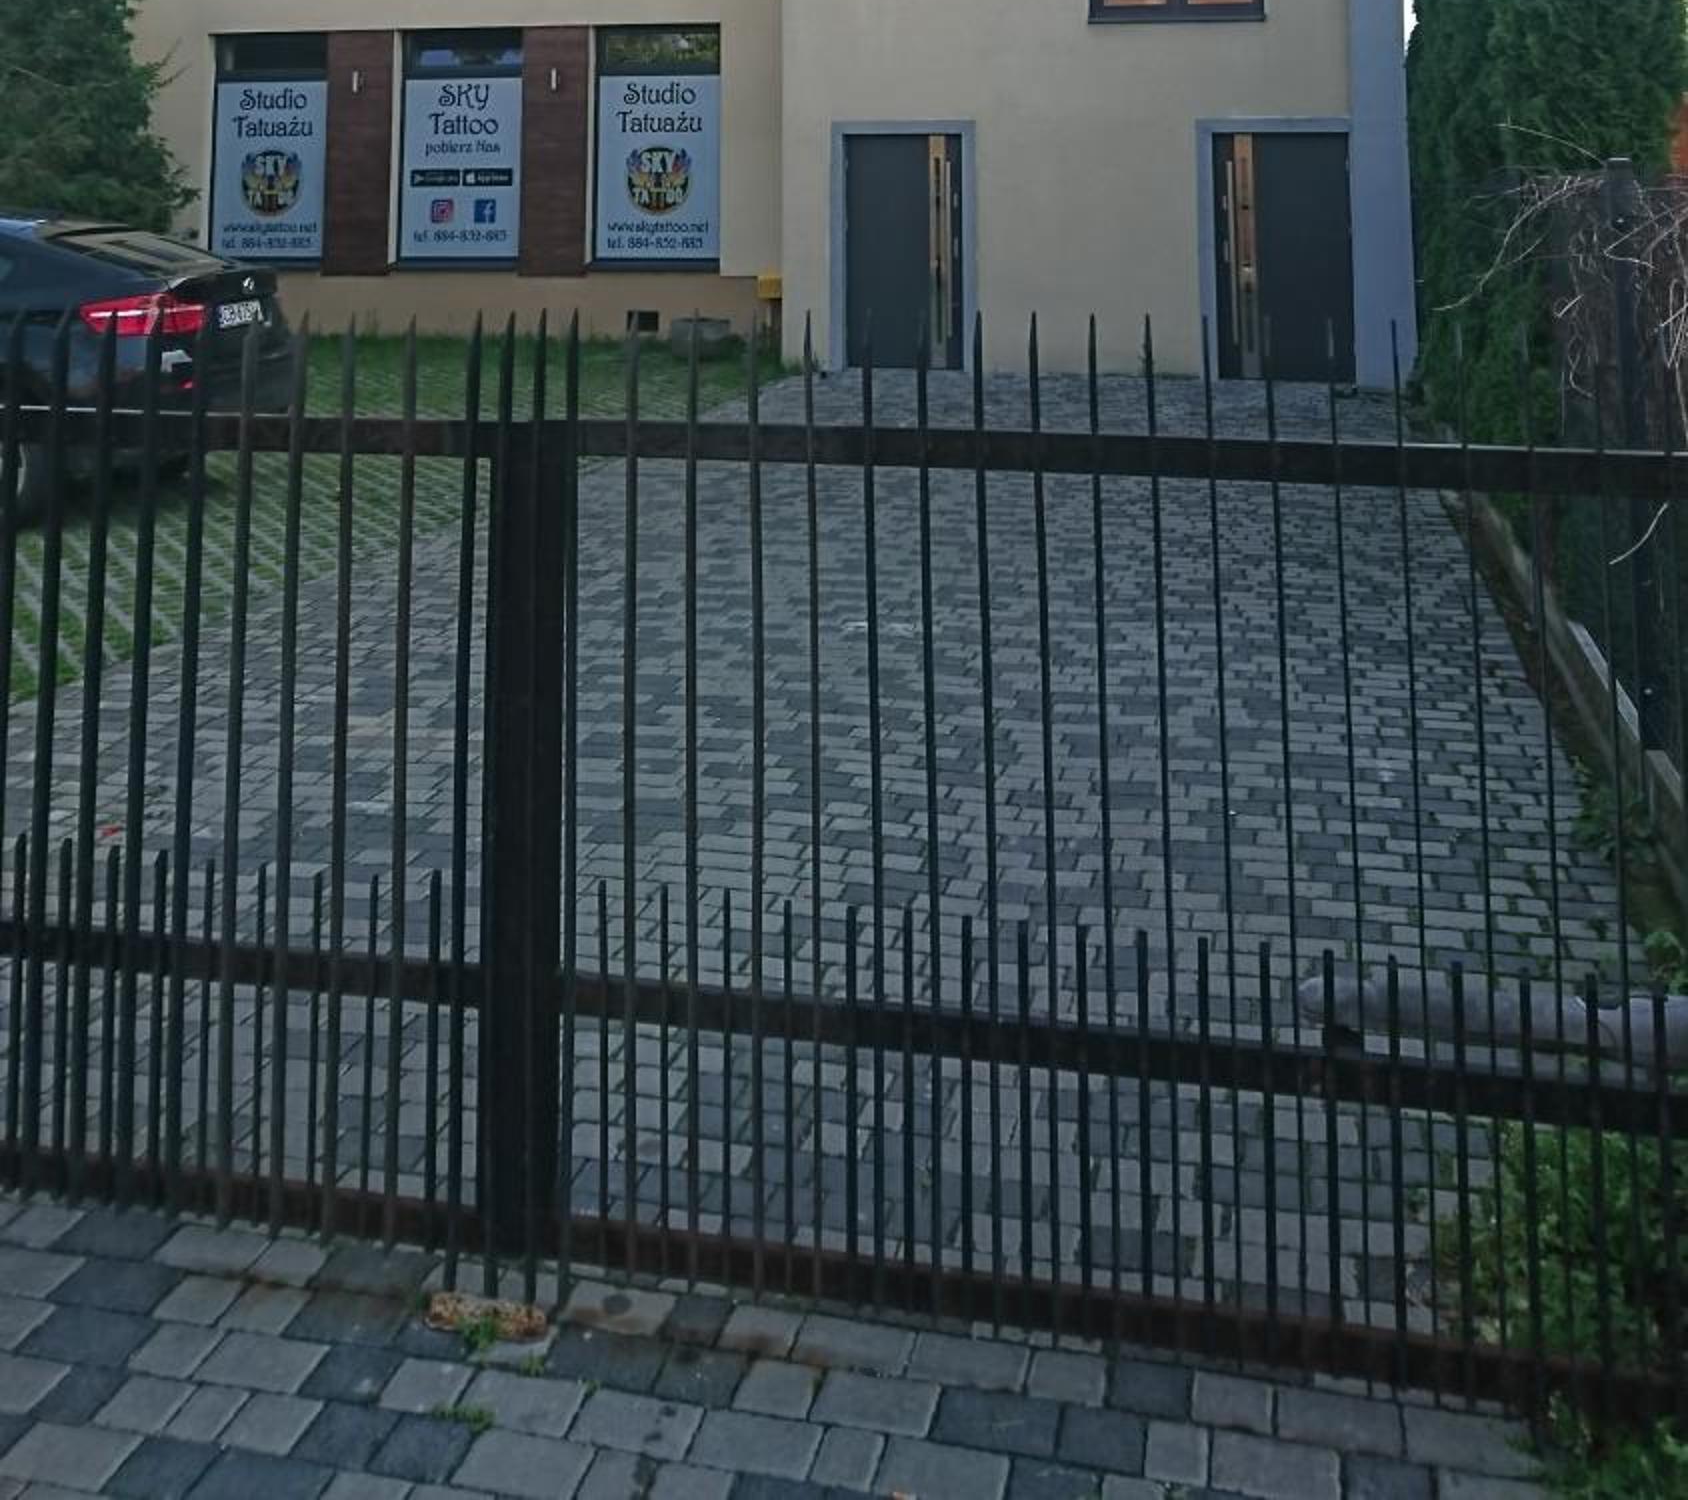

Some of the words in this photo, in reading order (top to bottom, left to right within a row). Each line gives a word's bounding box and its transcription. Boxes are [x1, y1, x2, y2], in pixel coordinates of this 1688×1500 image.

[240, 87, 307, 110] Studio
[438, 83, 490, 111] SKY
[623, 81, 697, 105] Studio
[231, 116, 315, 138] Tatuażu
[429, 111, 499, 135] Tattoo
[615, 110, 703, 133] Tatuażu
[425, 141, 473, 157] pobierz
[255, 155, 289, 176] SKY
[641, 151, 674, 173] SKY
[631, 187, 684, 209] TATTOO
[607, 236, 625, 249] tel.
